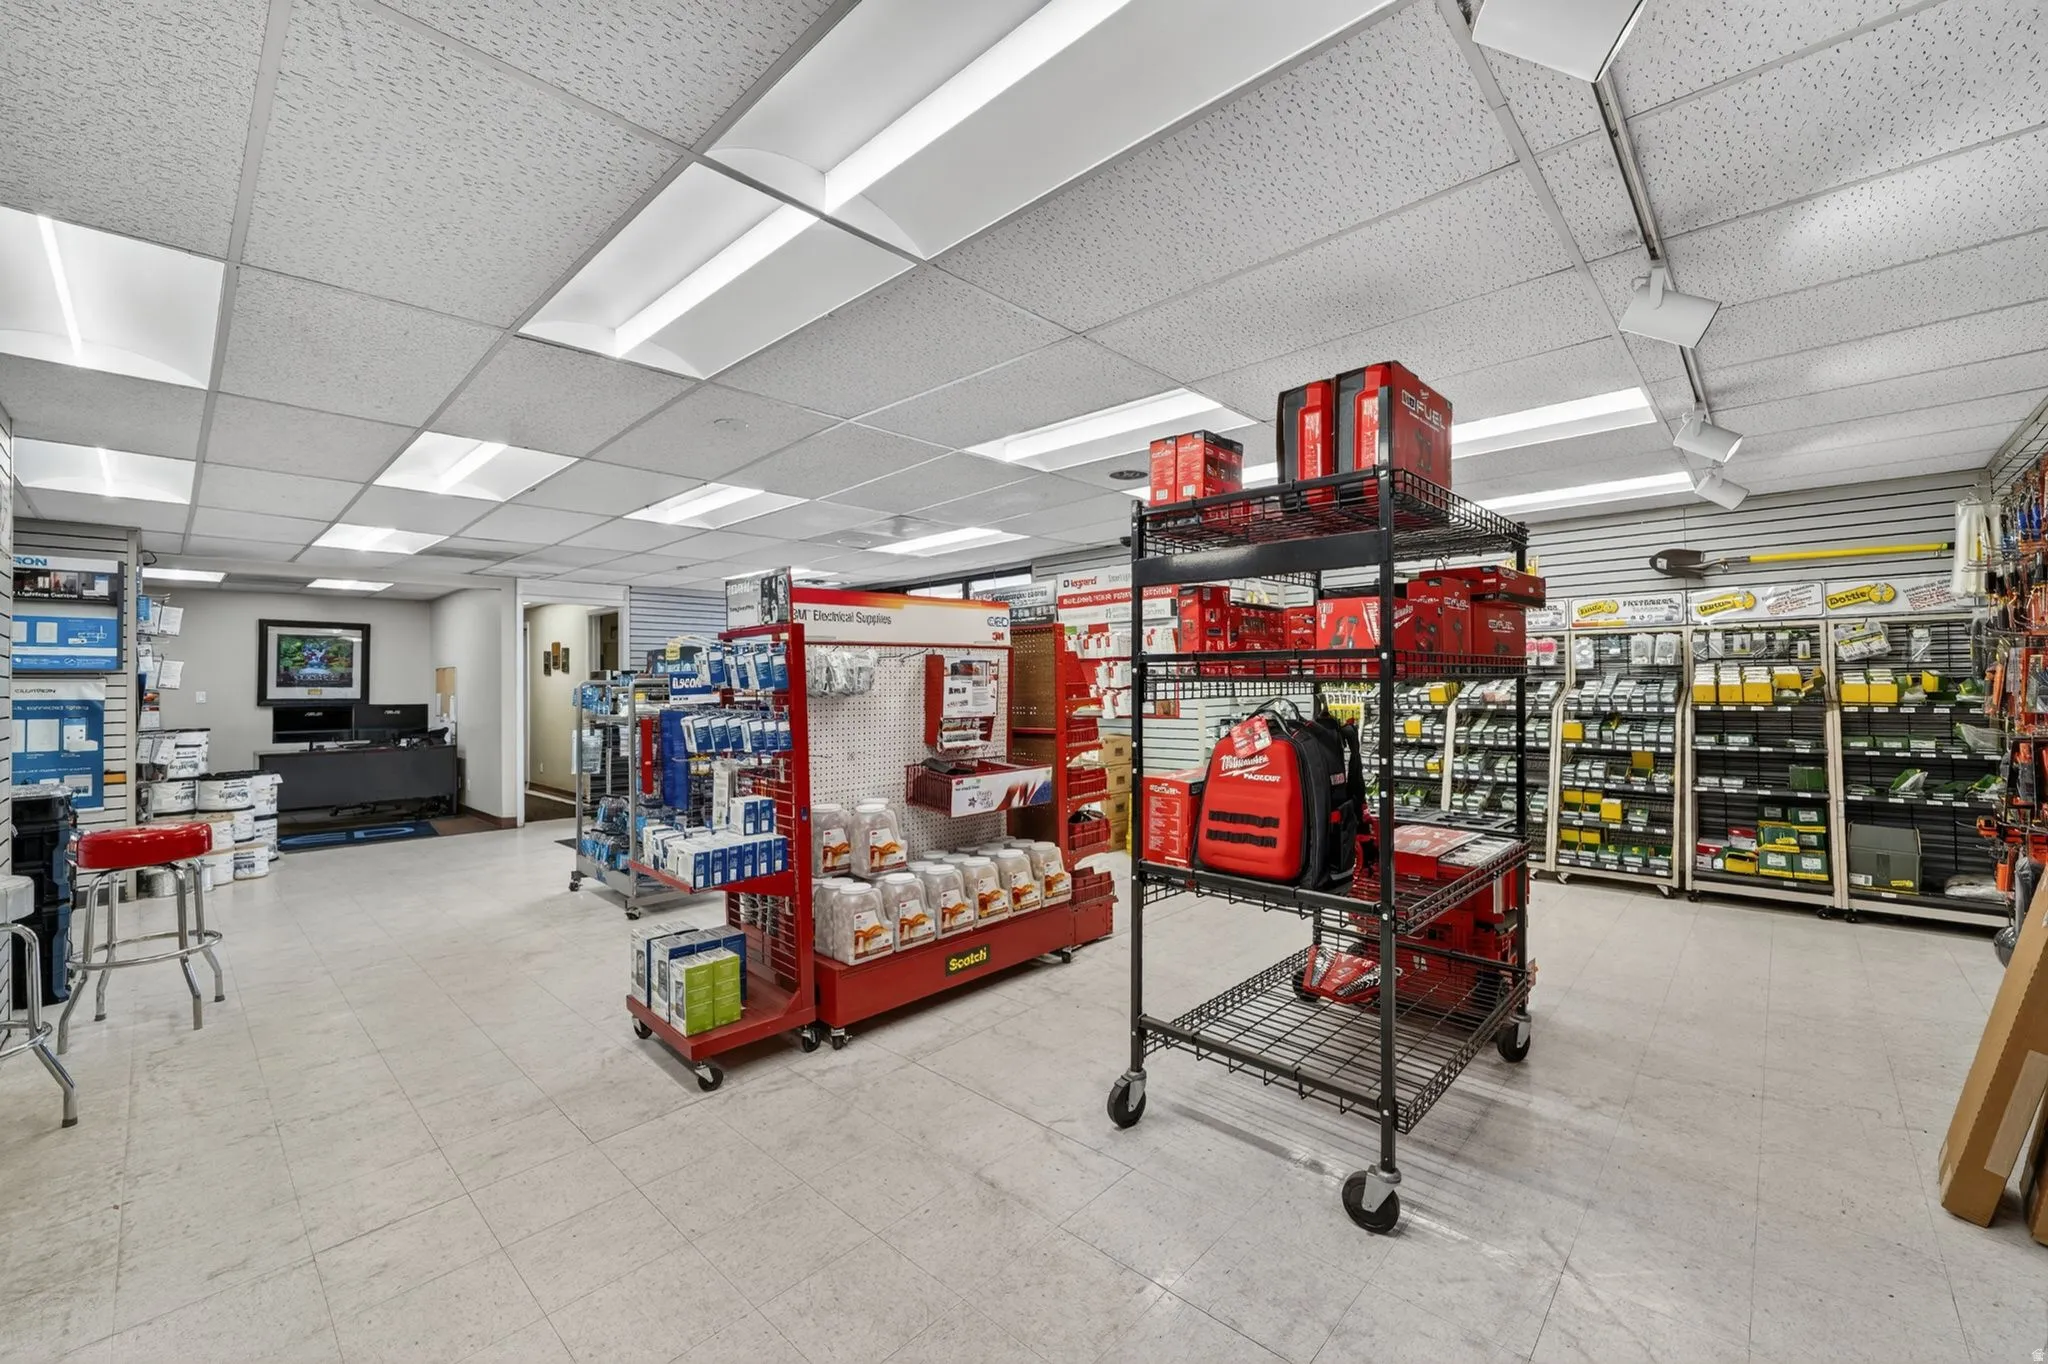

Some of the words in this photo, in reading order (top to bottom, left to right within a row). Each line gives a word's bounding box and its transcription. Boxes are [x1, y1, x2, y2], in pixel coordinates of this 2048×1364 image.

[1071, 576, 1097, 589] legrand
[813, 609, 854, 622] Electrical
[856, 611, 892, 626] Supplies
[949, 946, 987, 971] Scotch
